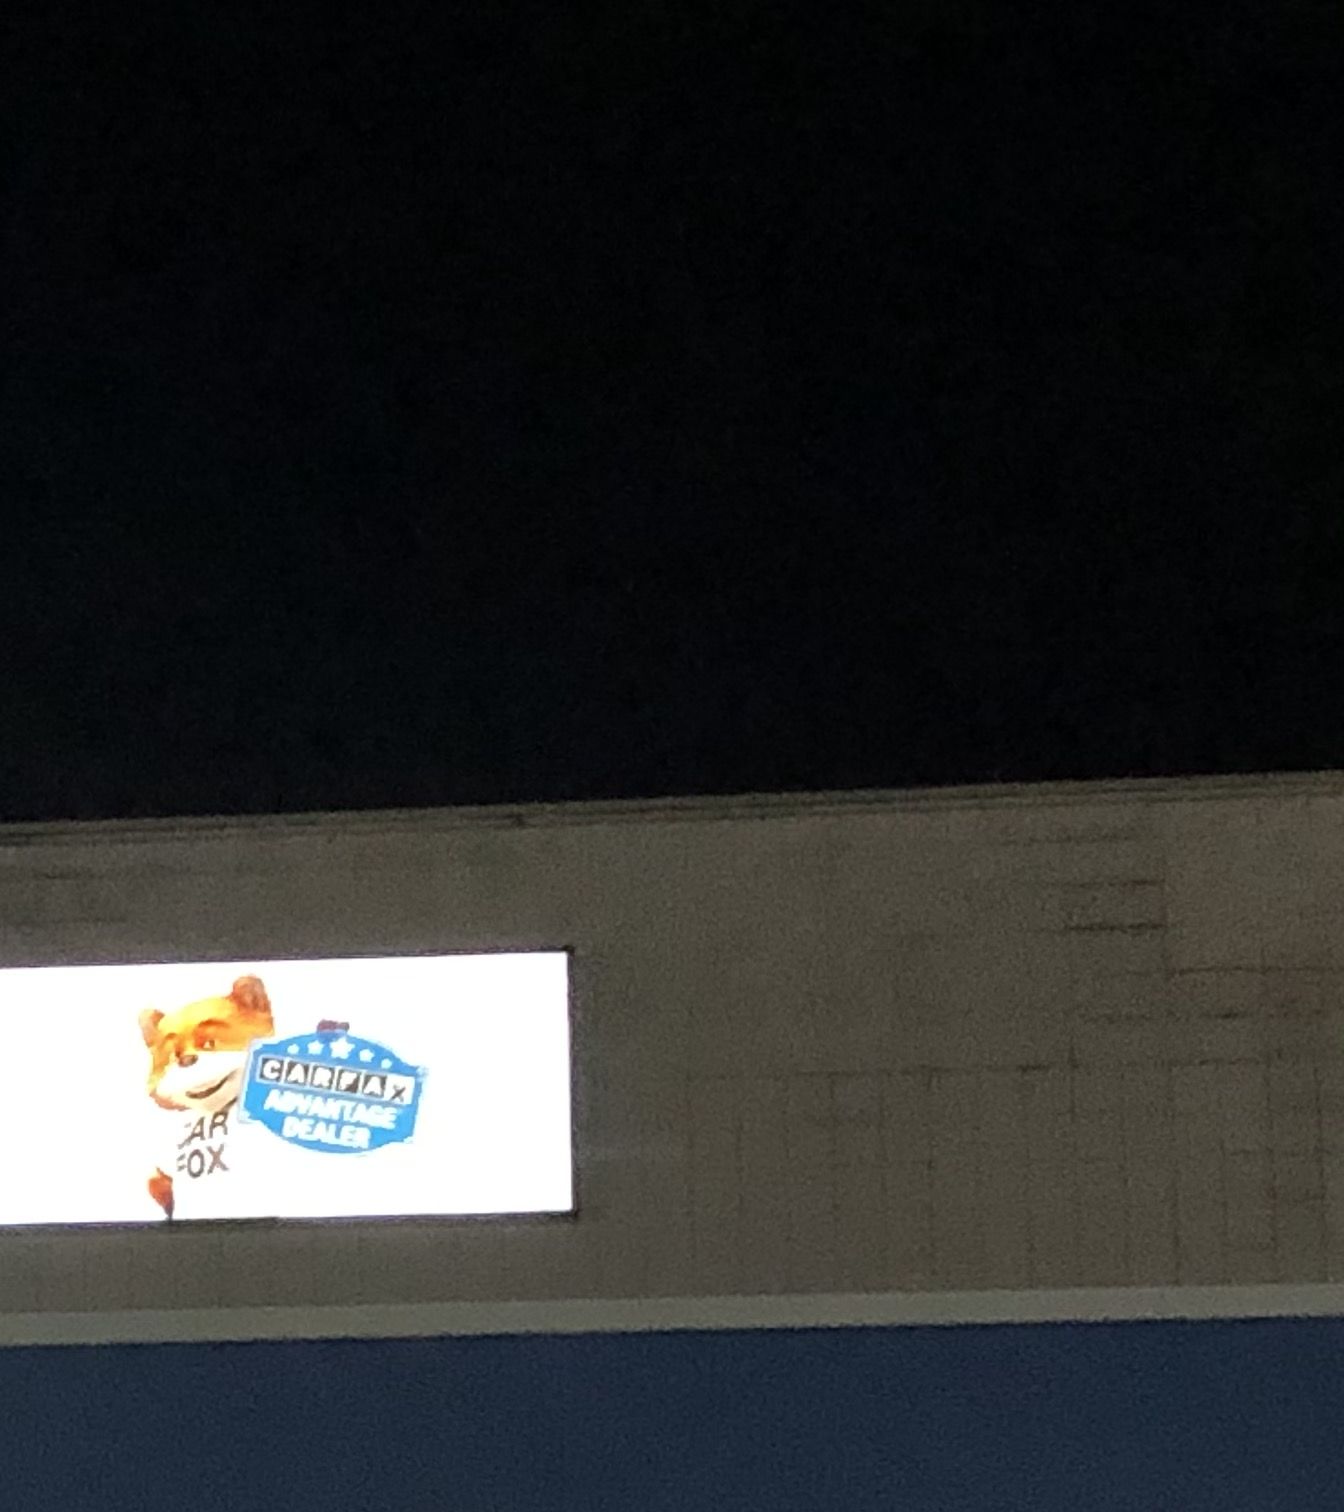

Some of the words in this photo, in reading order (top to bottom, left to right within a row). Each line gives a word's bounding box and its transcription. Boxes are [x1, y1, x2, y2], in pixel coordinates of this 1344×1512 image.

[261, 1057, 406, 1103] CARFAX
[263, 1089, 398, 1130] ADVANTAGE
[282, 1115, 372, 1149] DEALER
